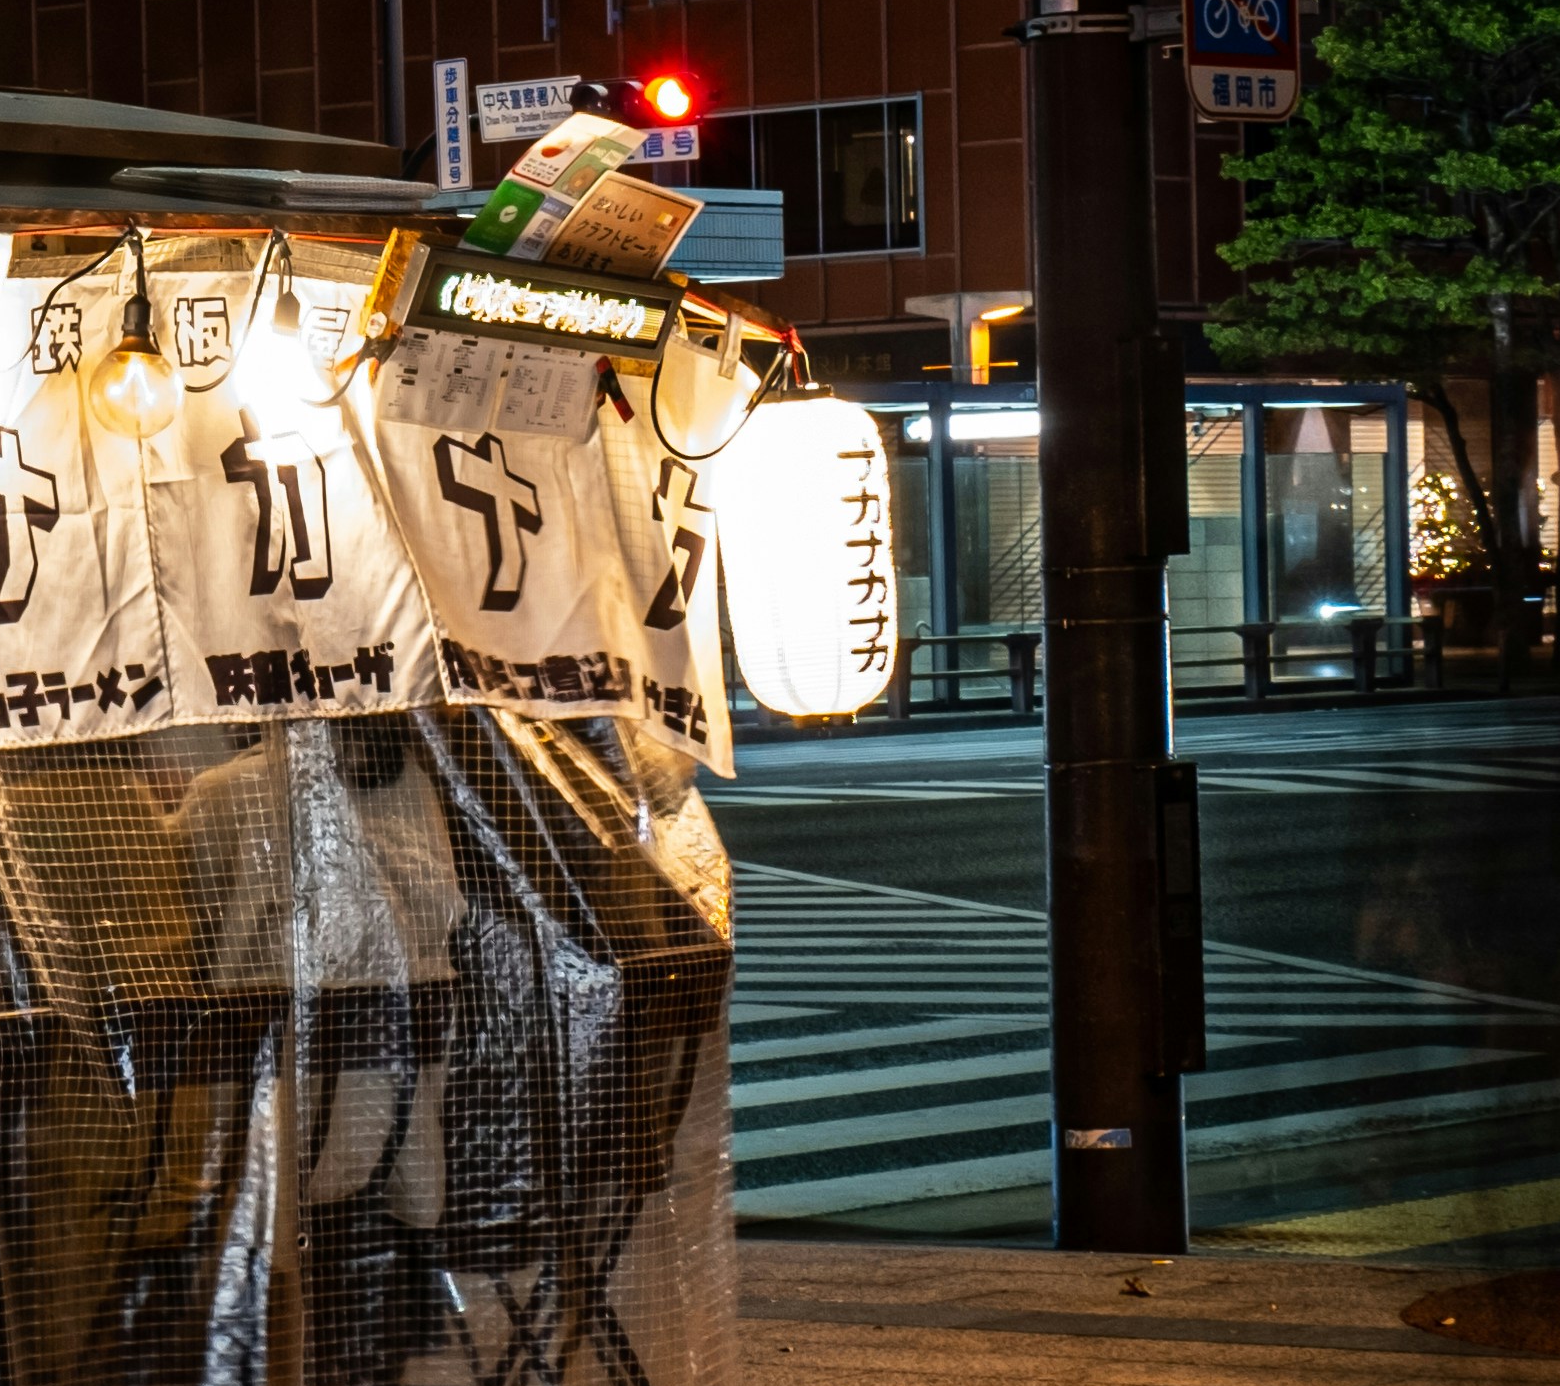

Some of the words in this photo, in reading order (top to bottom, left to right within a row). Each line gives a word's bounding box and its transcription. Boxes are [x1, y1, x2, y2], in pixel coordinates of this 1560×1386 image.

[1212, 74, 1276, 109] 福岡市
[443, 67, 462, 183] 歩車分離信号
[627, 130, 695, 159] 信号
[556, 242, 614, 272] あります
[572, 218, 662, 261] クラフトビール
